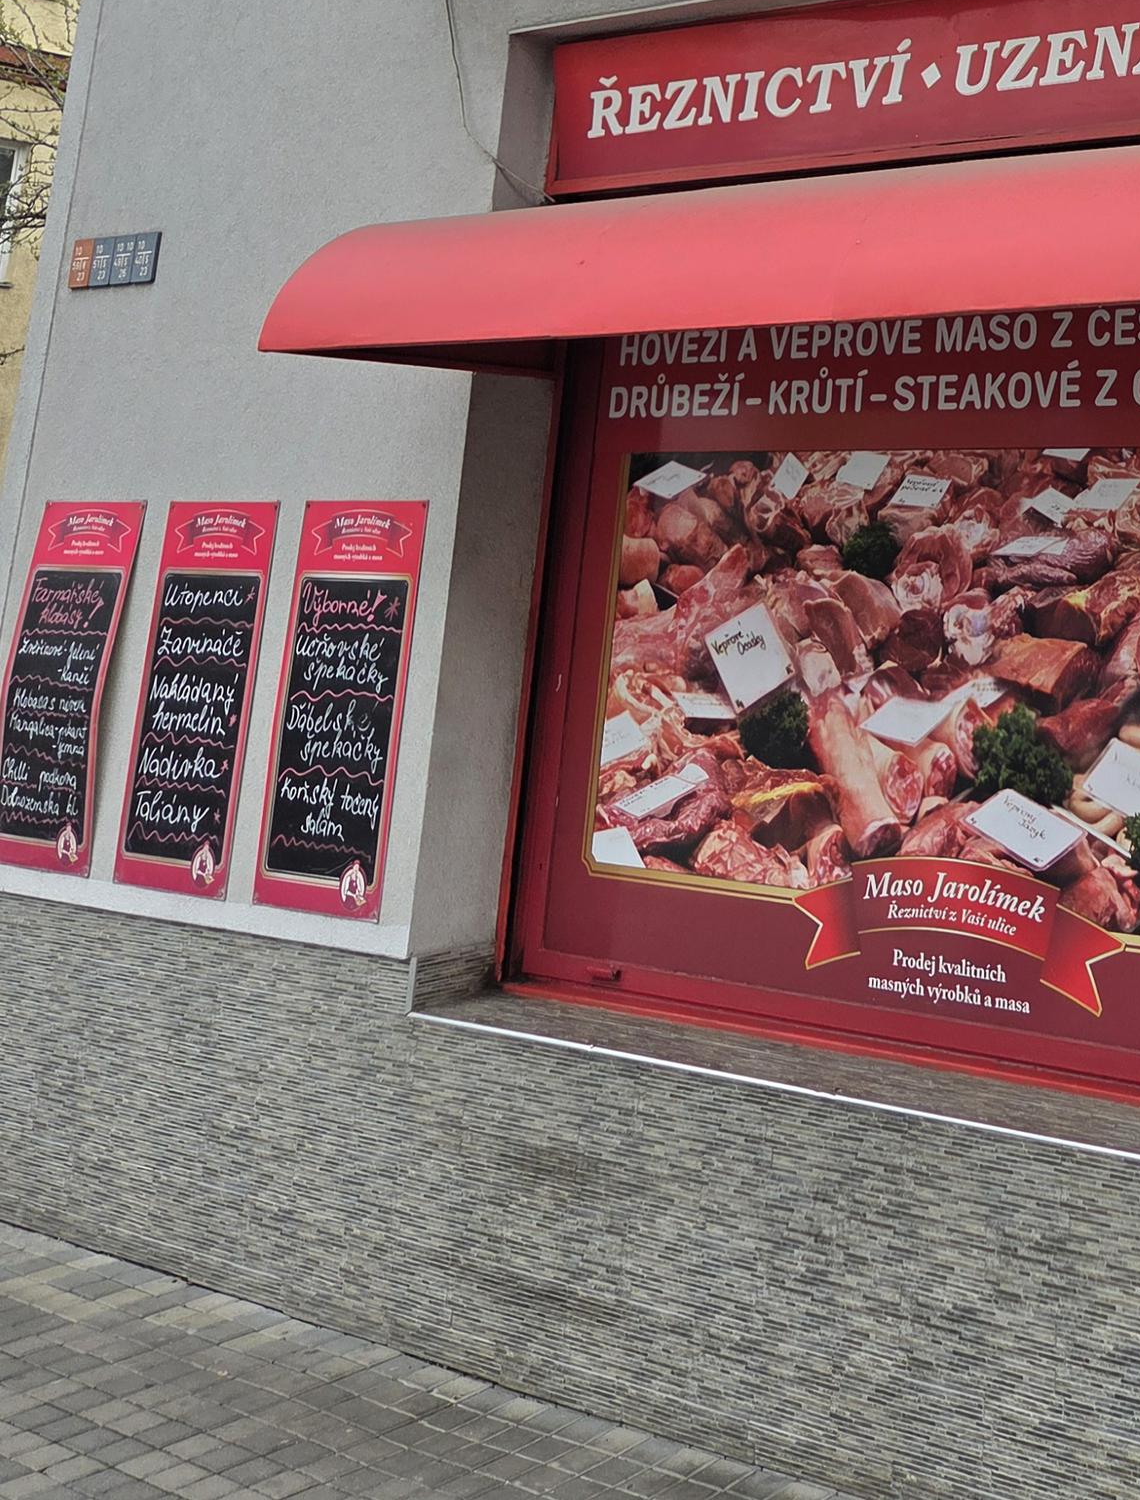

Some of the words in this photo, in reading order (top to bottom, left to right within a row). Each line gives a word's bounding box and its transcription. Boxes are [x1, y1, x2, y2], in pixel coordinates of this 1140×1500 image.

[587, 38, 912, 139] ŘEZNICTVÍ
[737, 327, 757, 362] A
[935, 311, 1037, 353] MASO
[1050, 311, 1074, 348] Z
[1095, 368, 1118, 408] Z
[164, 582, 243, 613] Utopenci
[138, 746, 222, 780] Nádivka
[863, 871, 924, 900] Maso
[928, 871, 1046, 923] Jarolímek
[887, 900, 948, 921] Řeznictví
[949, 909, 958, 922] z
[961, 908, 986, 928] Vaší
[987, 916, 1018, 936] ulice
[892, 948, 937, 977] Prodej
[938, 956, 1007, 983] kvalitních
[868, 974, 925, 998] masných
[926, 984, 982, 1007] výrobků
[984, 993, 993, 1007] a
[994, 996, 1031, 1014] masa
